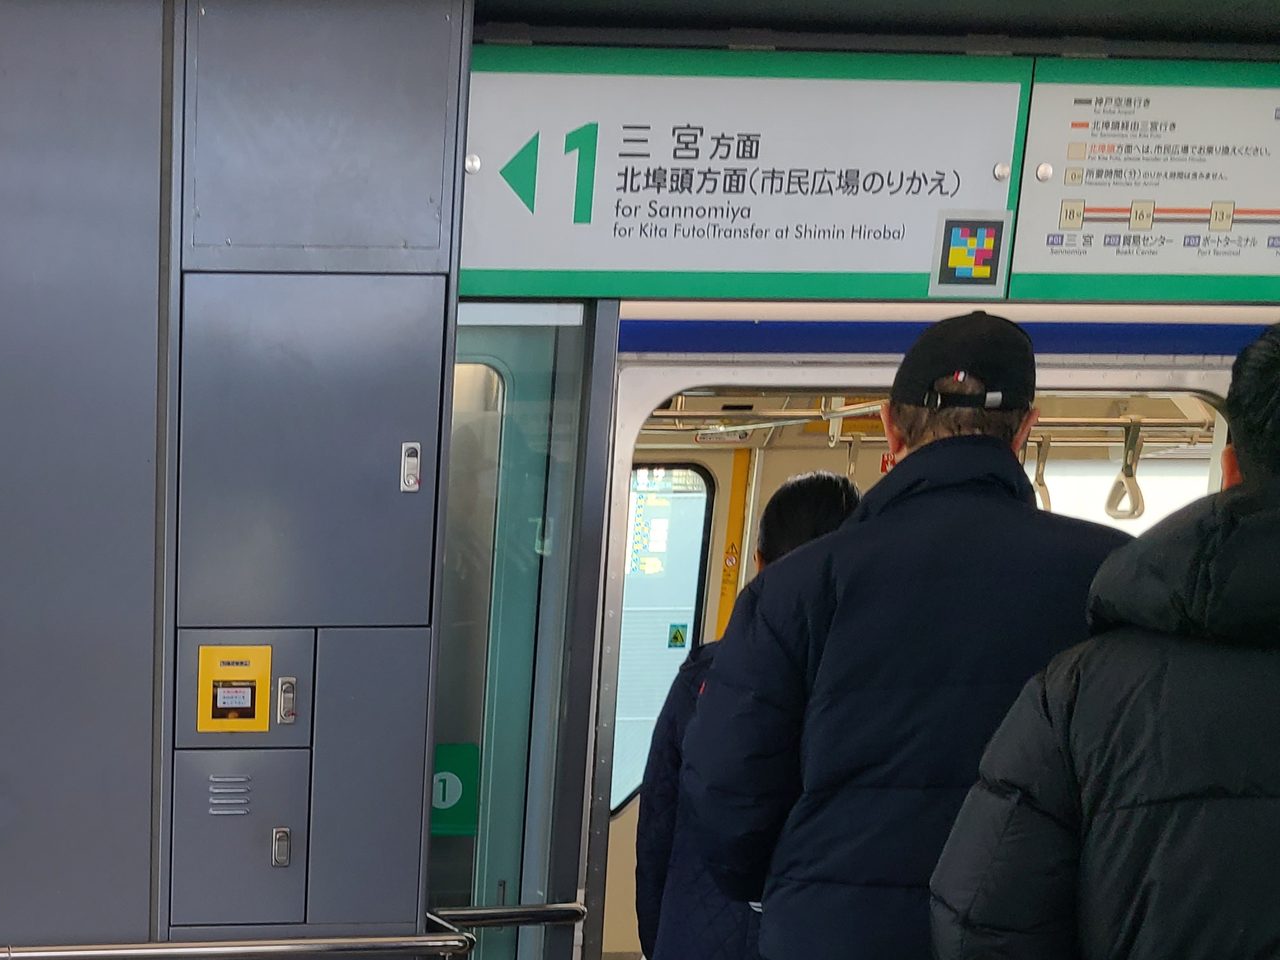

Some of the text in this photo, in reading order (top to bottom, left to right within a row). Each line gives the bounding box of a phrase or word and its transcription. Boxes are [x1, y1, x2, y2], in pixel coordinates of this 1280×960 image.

[563, 122, 599, 225] 1
[614, 199, 752, 224] for Sannomiya
[613, 222, 635, 239] for
[638, 222, 668, 239] Kita
[774, 224, 790, 240] at
[794, 224, 846, 241] Shimin
[850, 223, 907, 242] Hiroba)
[437, 778, 448, 803] 1
